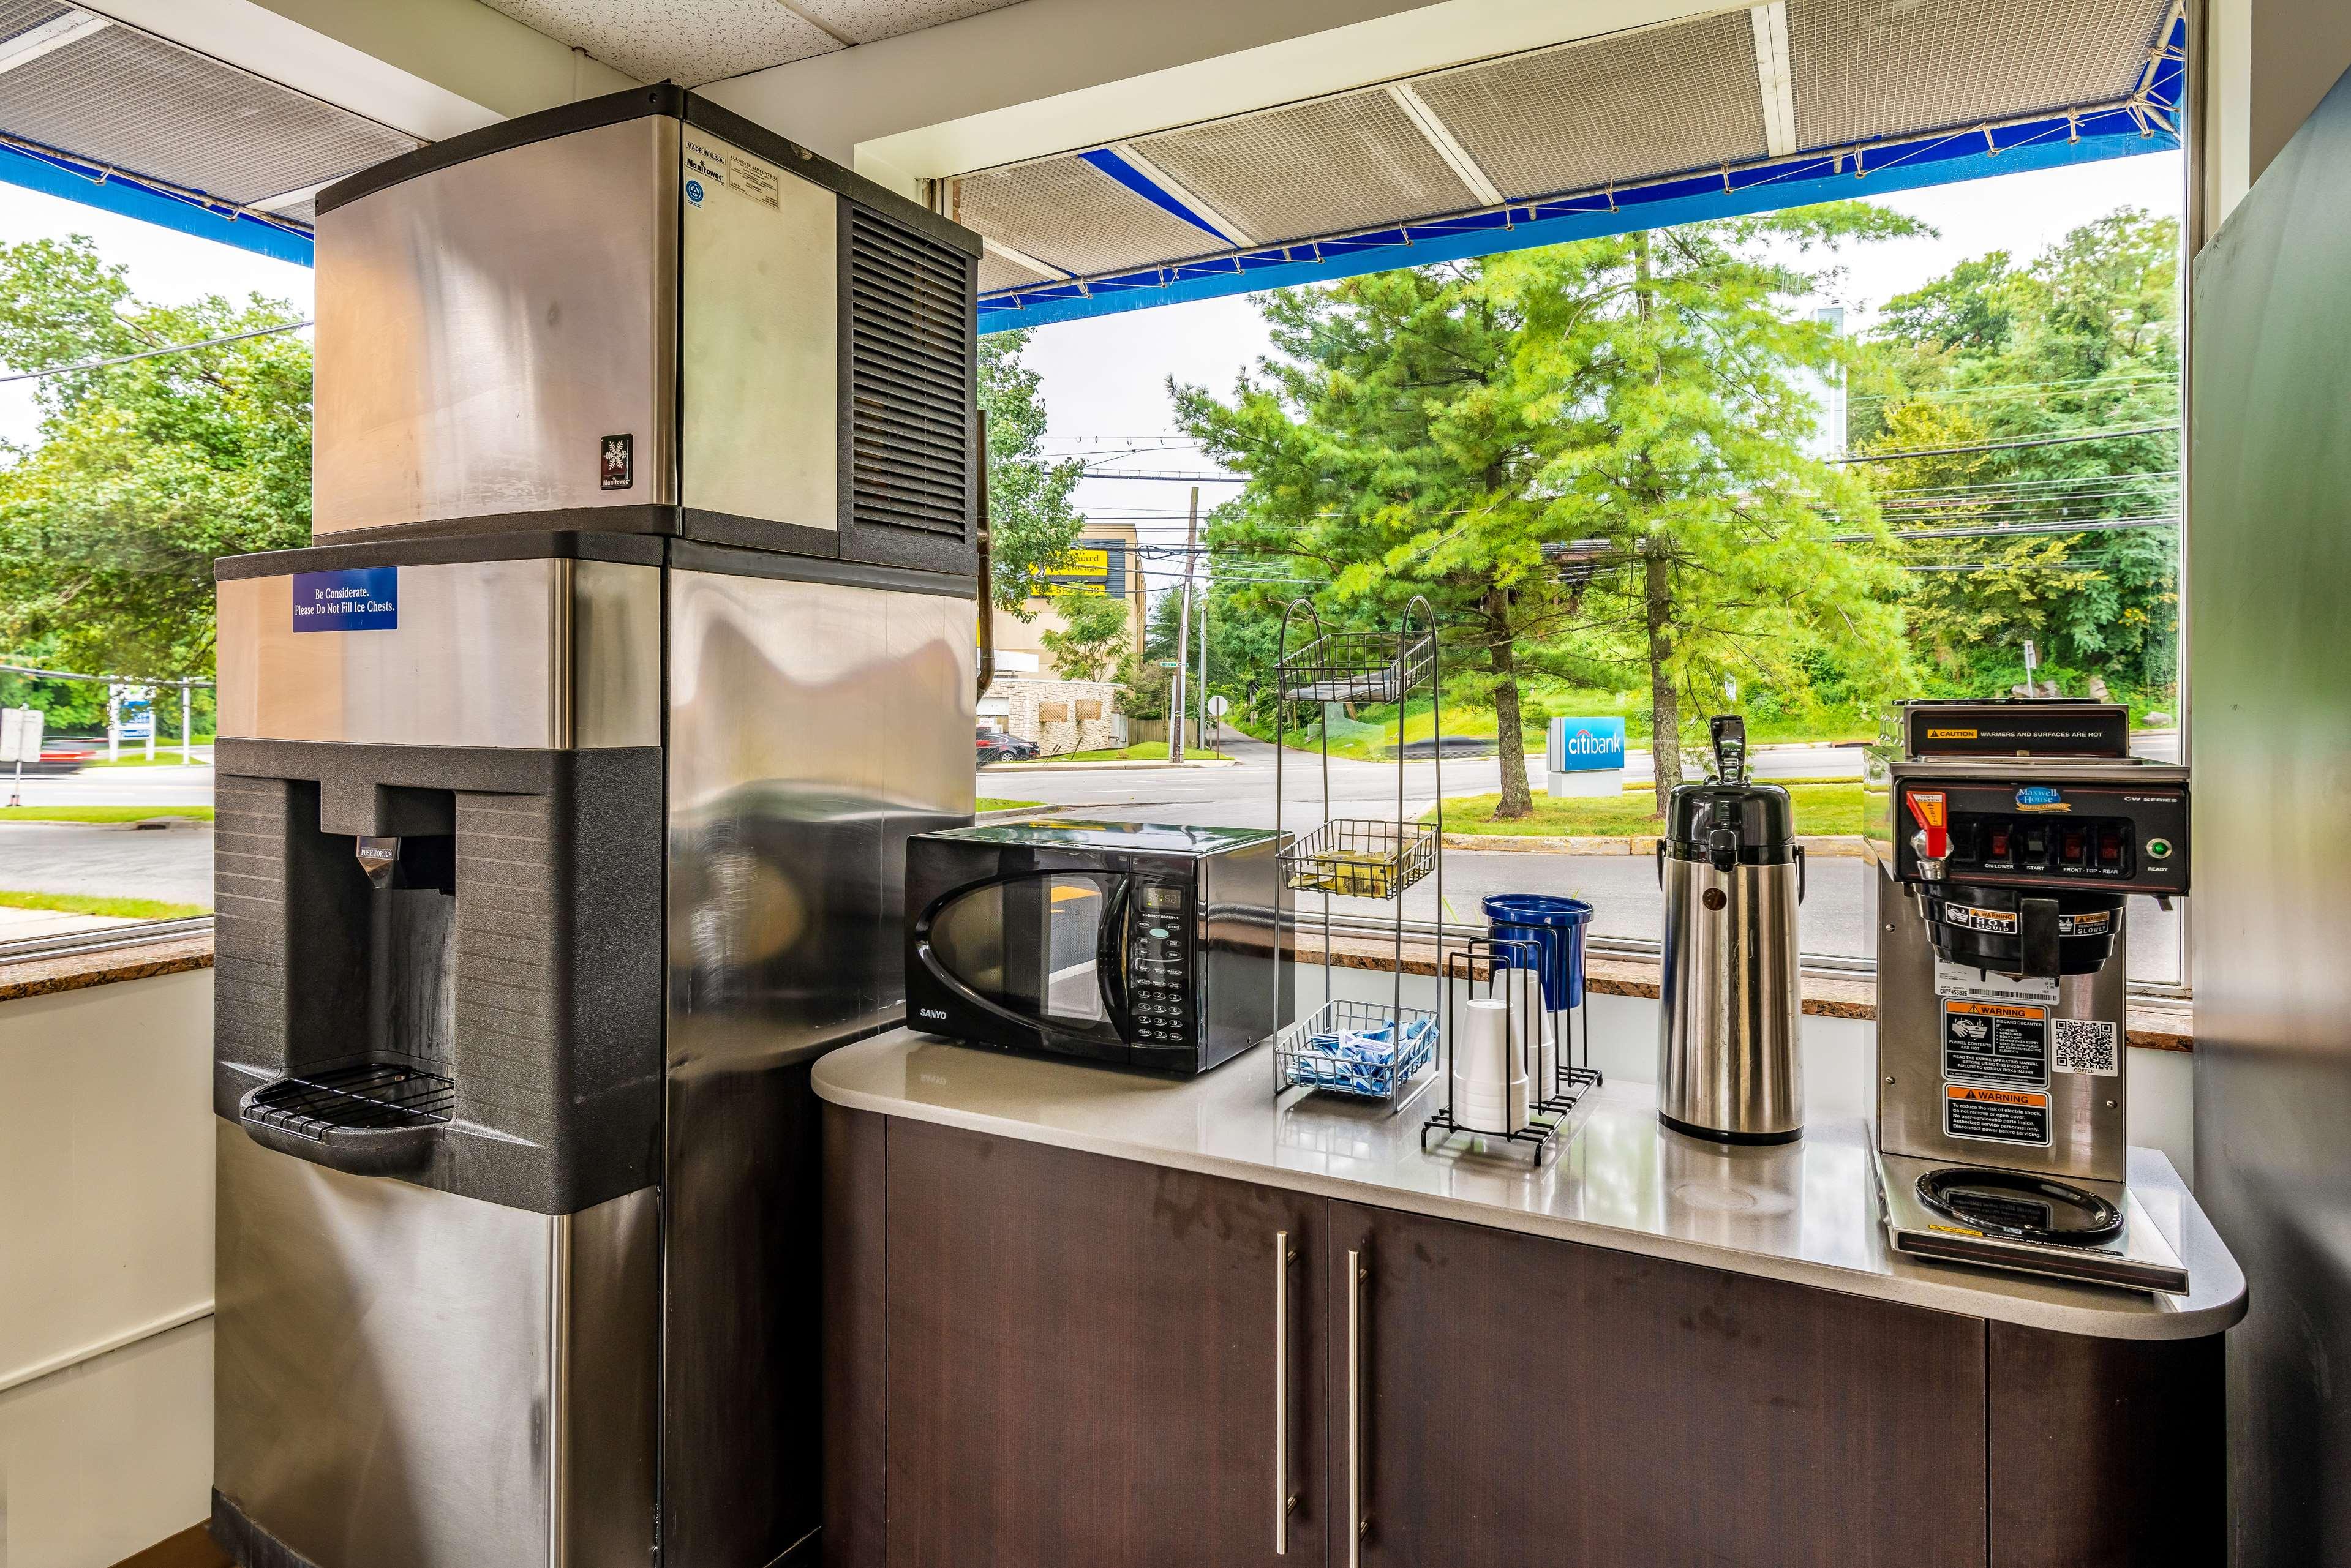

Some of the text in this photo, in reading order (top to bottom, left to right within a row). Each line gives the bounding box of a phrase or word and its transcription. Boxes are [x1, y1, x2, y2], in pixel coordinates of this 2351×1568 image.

[687, 142, 703, 153] MADE
[687, 158, 723, 180] Manitowoc
[759, 170, 778, 181] CONTROL
[315, 587, 369, 600] Be Considerate.
[295, 601, 395, 616] Please Do Not Fill Ice Chests.
[1568, 732, 1621, 754] citibank
[1976, 918, 2009, 927] HOT
[2078, 926, 2105, 934] SLOWLY
[920, 1008, 947, 1019] SANYO
[1981, 1007, 2025, 1016] WARNING
[1978, 1092, 2028, 1103] WARNING
